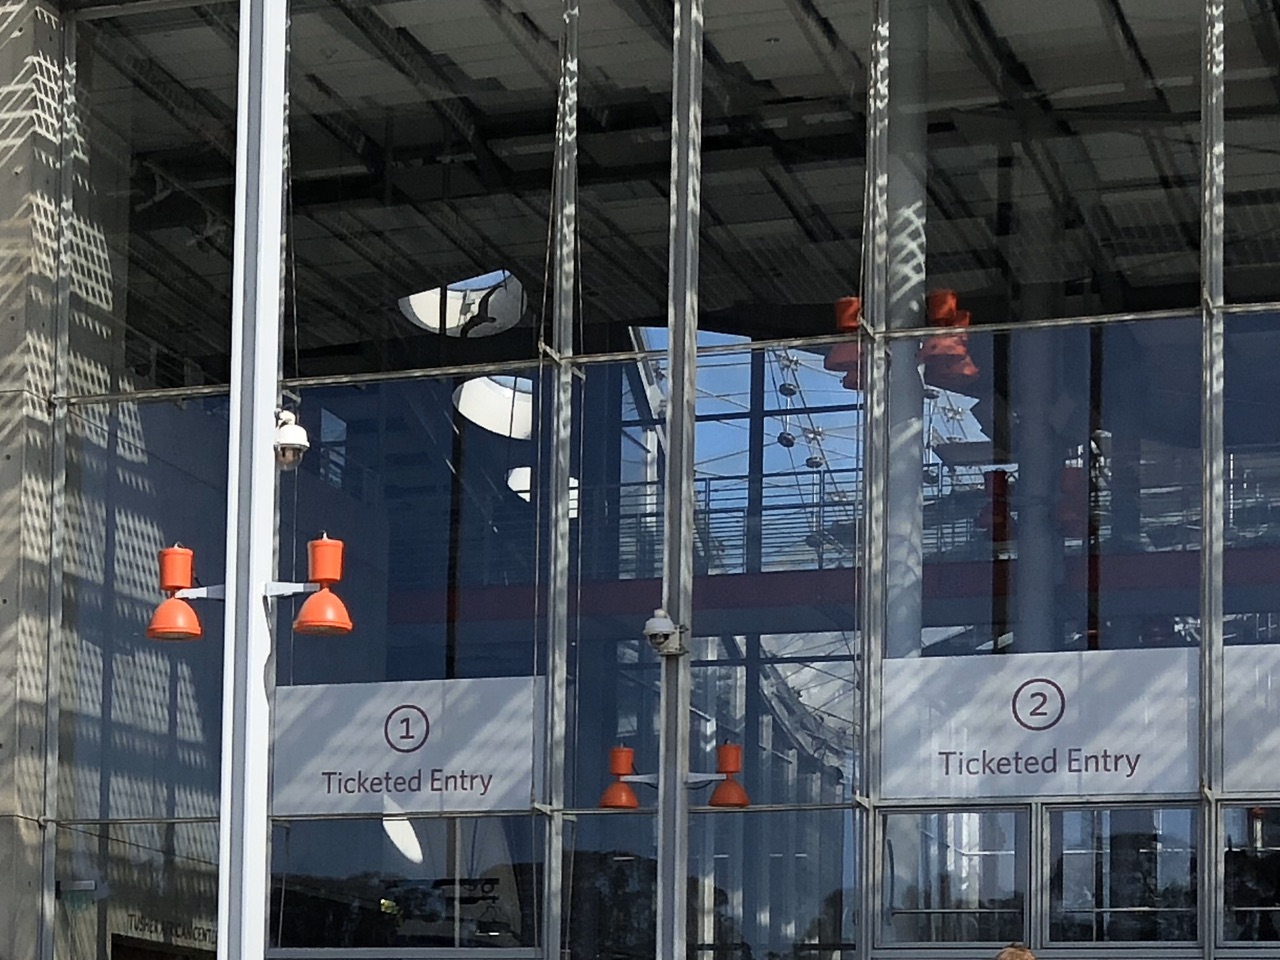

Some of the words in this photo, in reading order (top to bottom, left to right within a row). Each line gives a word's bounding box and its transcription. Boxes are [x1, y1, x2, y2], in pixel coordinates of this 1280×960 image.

[1029, 692, 1048, 716] 2
[399, 718, 415, 739] 1
[938, 747, 1057, 776] Ticketed
[1067, 748, 1141, 777] Entry
[321, 769, 422, 794] Ticketed
[430, 769, 493, 795] Entry
